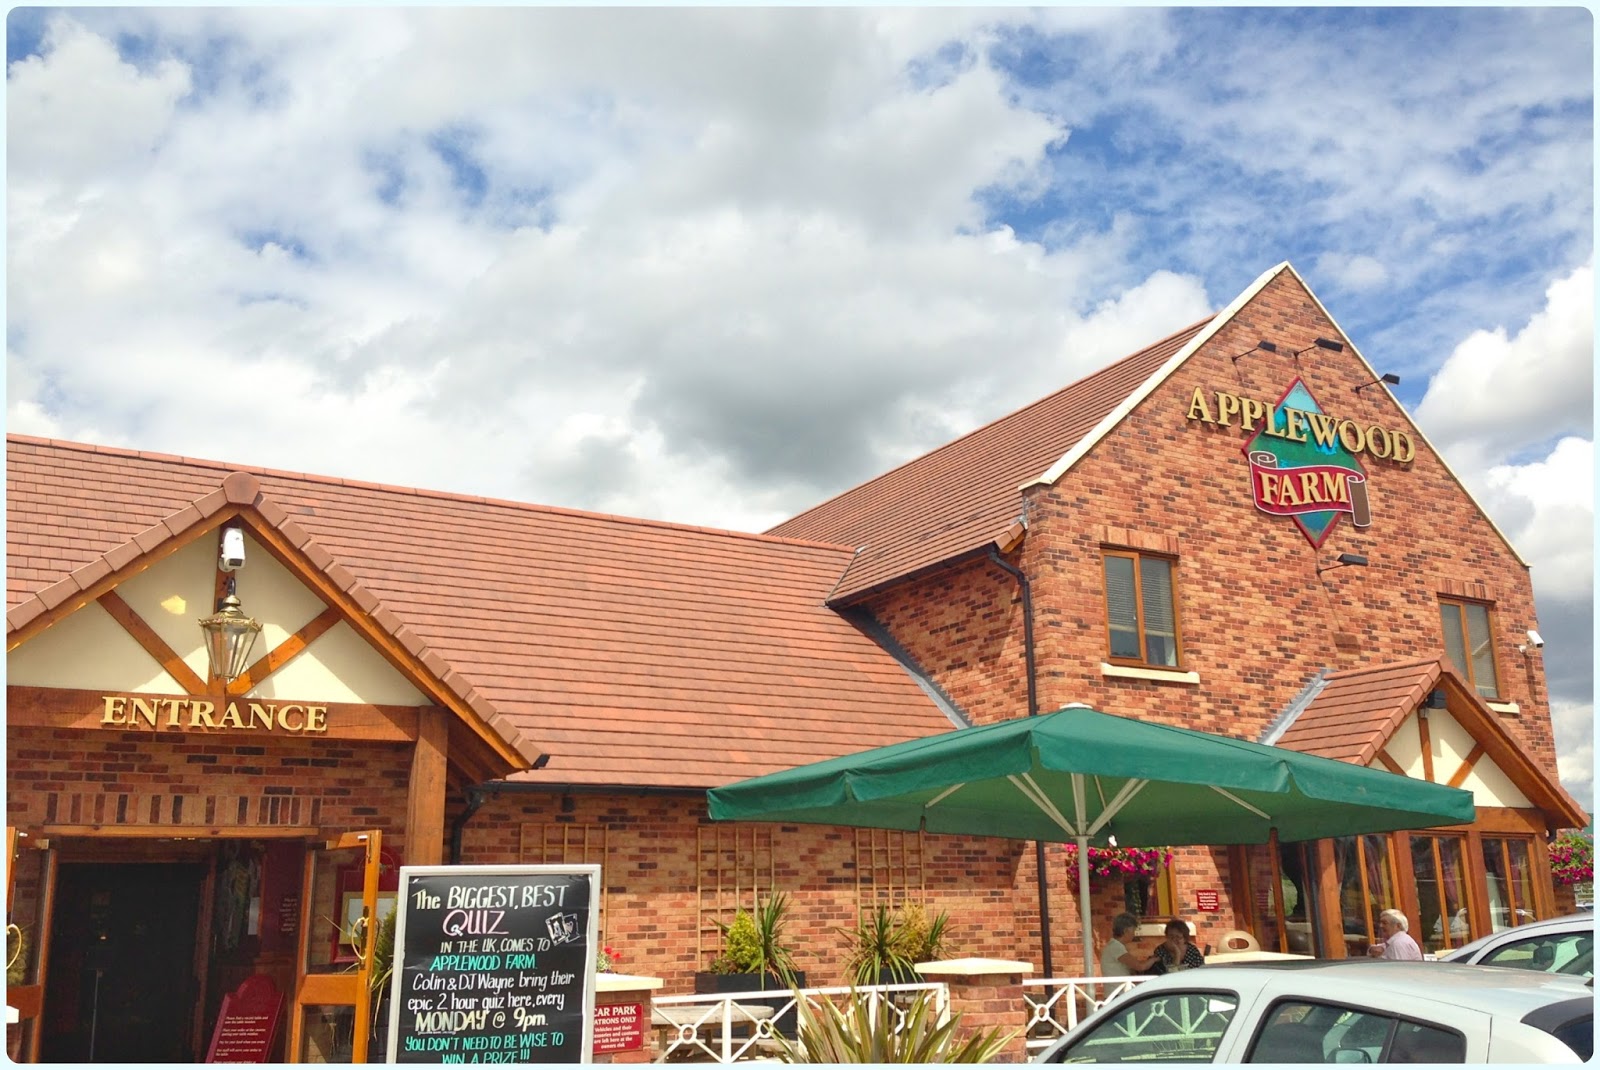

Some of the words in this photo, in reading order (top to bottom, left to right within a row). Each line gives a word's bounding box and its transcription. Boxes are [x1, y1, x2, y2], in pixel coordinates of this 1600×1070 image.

[1186, 385, 1416, 463] APPLEWOOD
[1258, 471, 1350, 507] FARM
[100, 696, 328, 732] ENTRANCE
[412, 888, 441, 910] The
[521, 885, 569, 908] BEST
[442, 909, 509, 937] QUIZ
[440, 941, 452, 953] IN
[457, 939, 478, 953] THE
[500, 938, 533, 953] COMES
[537, 937, 550, 952] TO
[429, 954, 501, 971] APPLEWOOD
[413, 973, 446, 991] Colin
[448, 977, 457, 990] &
[459, 973, 478, 990] DJ
[477, 974, 514, 995] Wayne
[519, 971, 548, 991] bring
[550, 970, 575, 986] their
[407, 997, 433, 1015] epic
[437, 993, 447, 1010] 2
[451, 992, 479, 1010] hour
[482, 994, 504, 1015] quiz
[535, 993, 565, 1011] every
[612, 1006, 637, 1016] PARK
[415, 1010, 487, 1032] MONDAY
[492, 1011, 506, 1029] @
[405, 1035, 425, 1051] YOU
[427, 1036, 459, 1051] DON'T
[462, 1036, 489, 1051] NEED
[490, 1035, 502, 1049] TO
[504, 1034, 518, 1049] BE
[520, 1032, 548, 1048] WISE
[551, 1031, 564, 1046] TO
[442, 1052, 466, 1064] WIN
[471, 1052, 479, 1064] A
